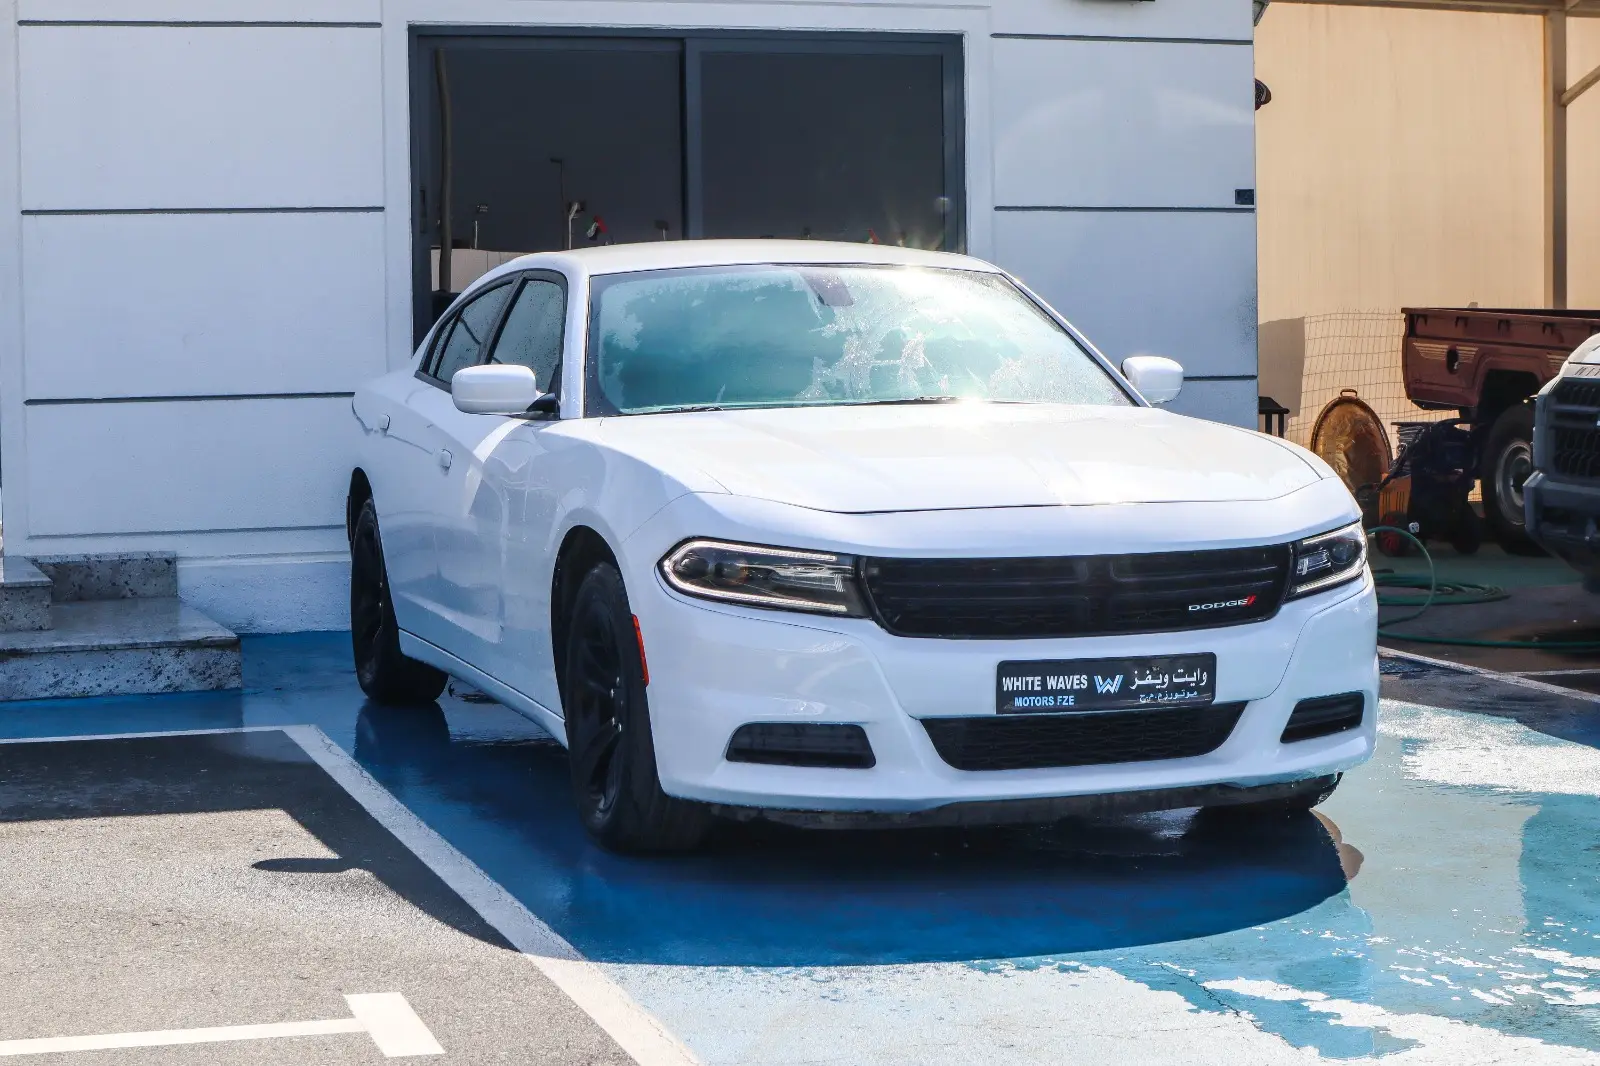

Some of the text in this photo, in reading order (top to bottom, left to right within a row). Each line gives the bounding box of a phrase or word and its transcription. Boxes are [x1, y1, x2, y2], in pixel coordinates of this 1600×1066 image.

[1188, 598, 1249, 611] DODGE
[1002, 674, 1088, 692] WHITE WAVES
[1172, 668, 1208, 687] وايت
[1014, 695, 1076, 707] MOTORS FZE
